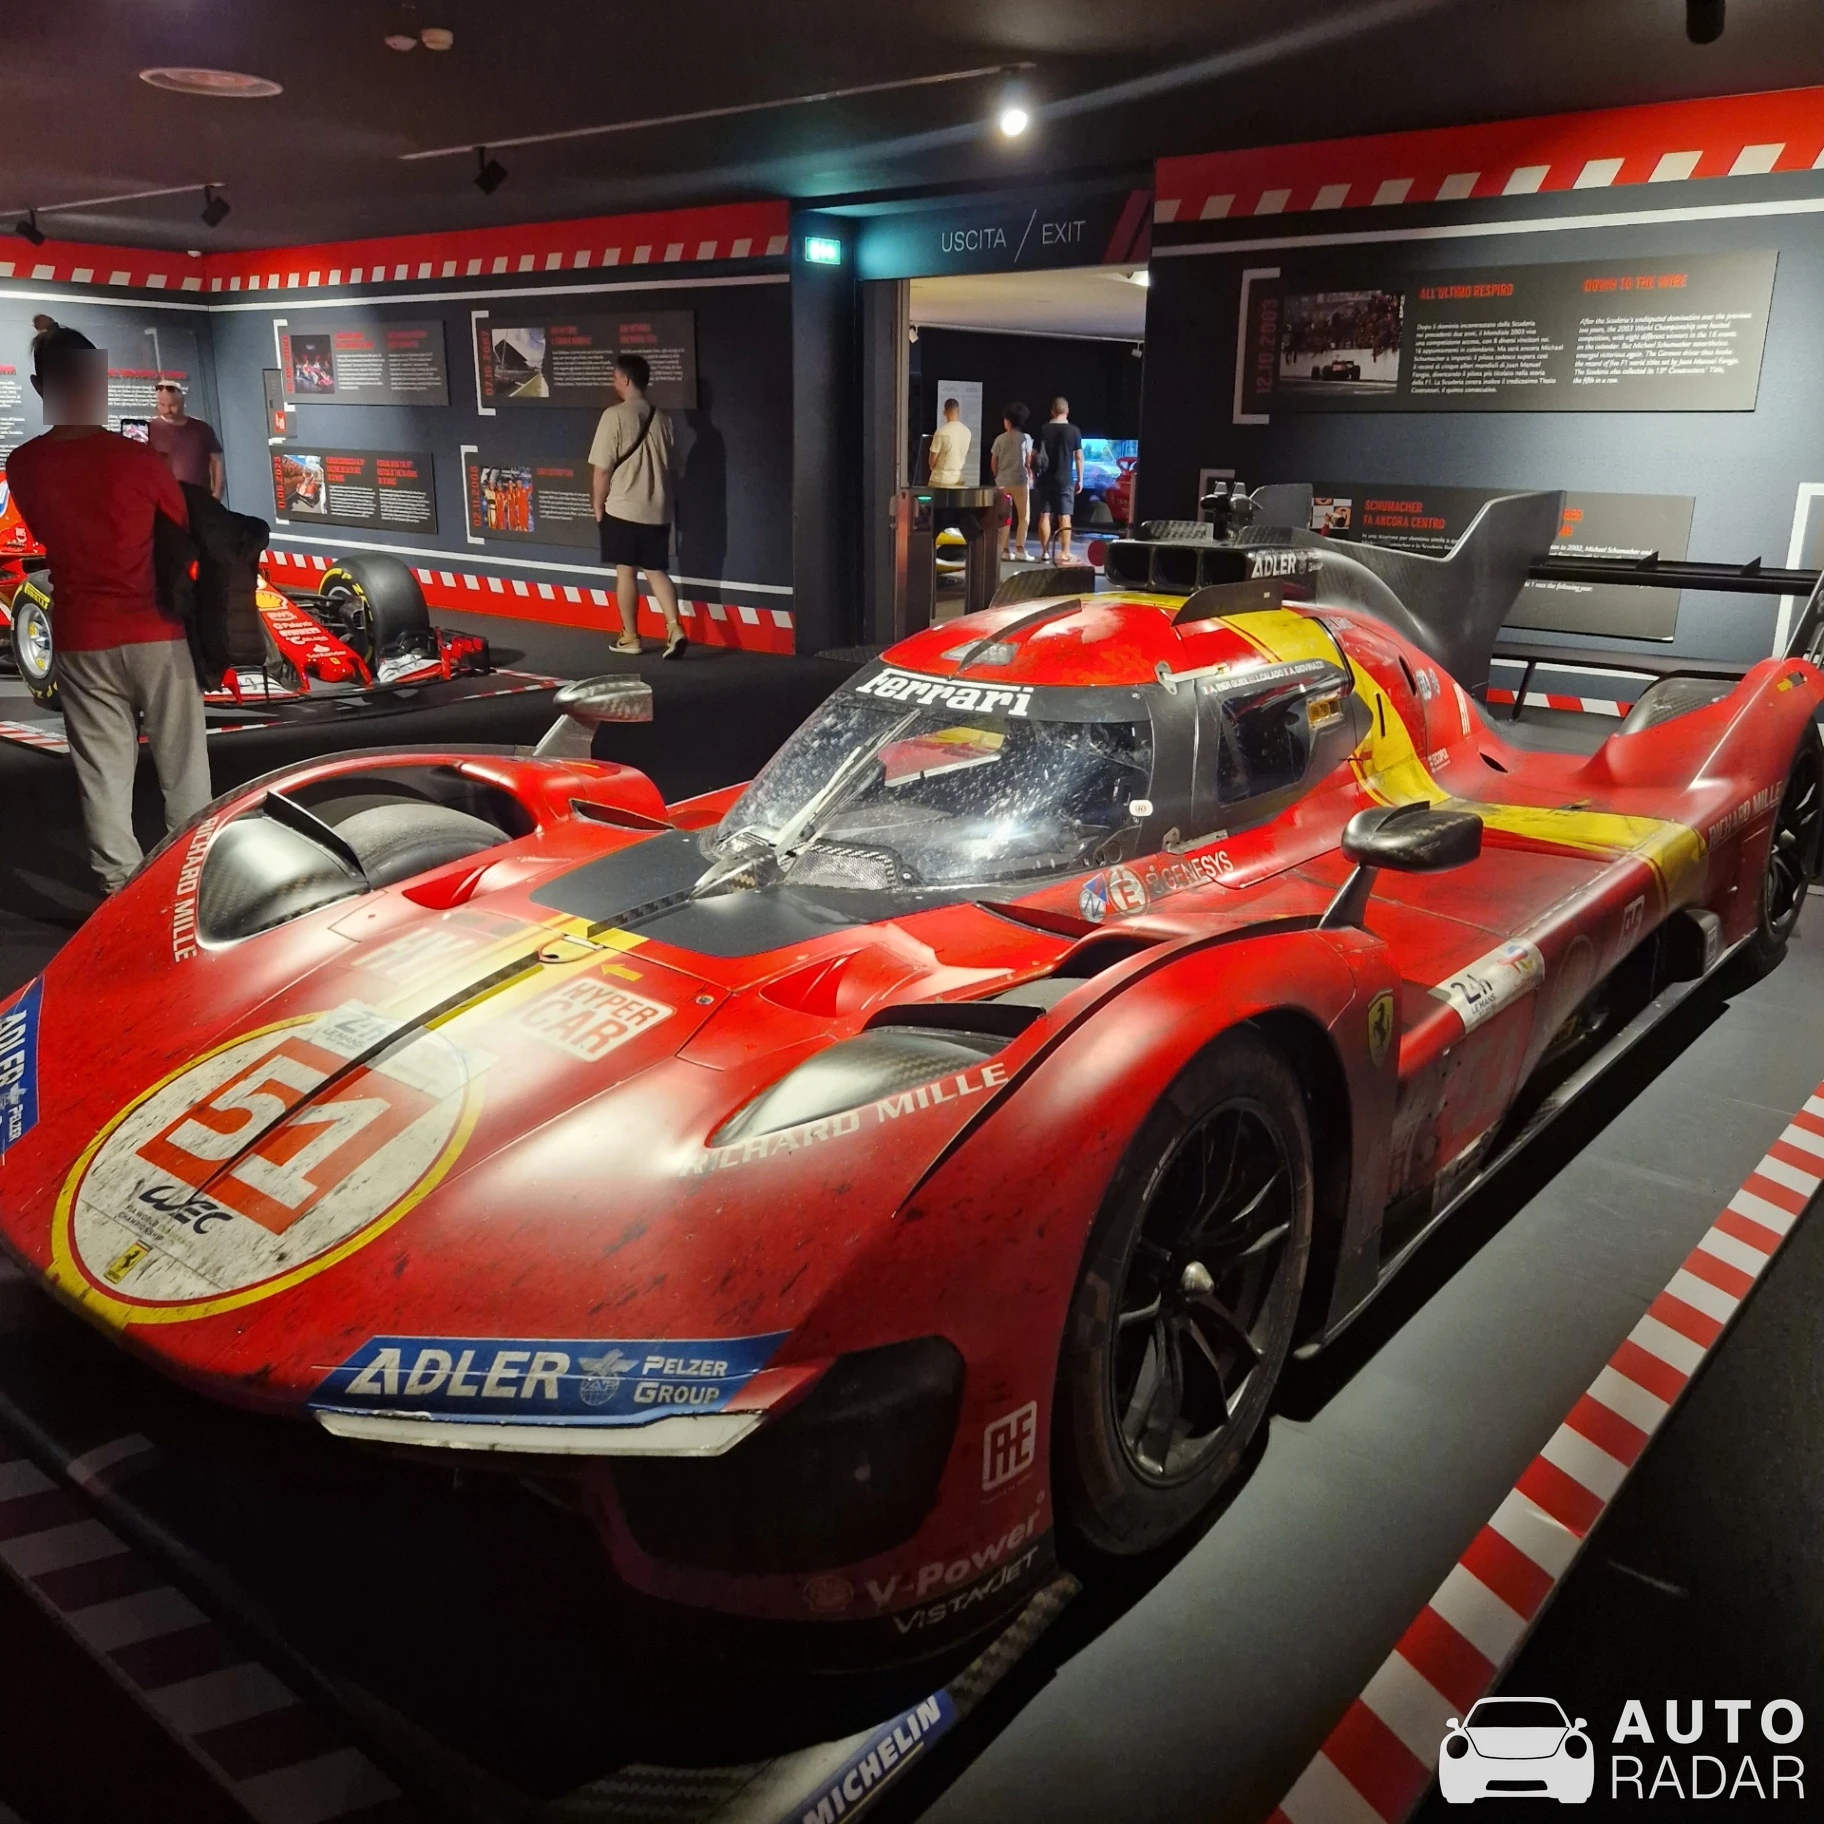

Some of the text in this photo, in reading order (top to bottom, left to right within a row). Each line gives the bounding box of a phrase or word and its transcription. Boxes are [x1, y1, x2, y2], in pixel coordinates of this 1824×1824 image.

[941, 228, 1007, 252] USCITA
[1042, 220, 1086, 244] EXIT
[1619, 277, 1633, 290] TO
[1635, 275, 1656, 290] THE
[1363, 515, 1446, 530] FA ANCORA CENTRO
[1364, 499, 1423, 513] SCHUMACHER
[1251, 553, 1297, 578] ADLER
[855, 668, 1035, 716] Ferrari
[1708, 781, 1783, 850] RICHARD MILLE
[172, 815, 220, 962] RICHARD MILLE
[1161, 850, 1234, 890] GENESYS
[562, 980, 658, 1026] HYPER
[1471, 993, 1496, 1015] LE MANS
[522, 1000, 629, 1054] CAR
[165, 1054, 392, 1210] 51
[678, 1063, 1008, 1178] RICHARD MILLE
[118, 1211, 164, 1242] CHAMPIONSHIP
[136, 1208, 159, 1227] WORLD
[345, 1348, 570, 1400] ADLER
[642, 1355, 729, 1377] PELZER
[633, 1381, 720, 1405] GROUP
[865, 1510, 1041, 1607] V-Power
[803, 1695, 941, 1824] MICHELIN
